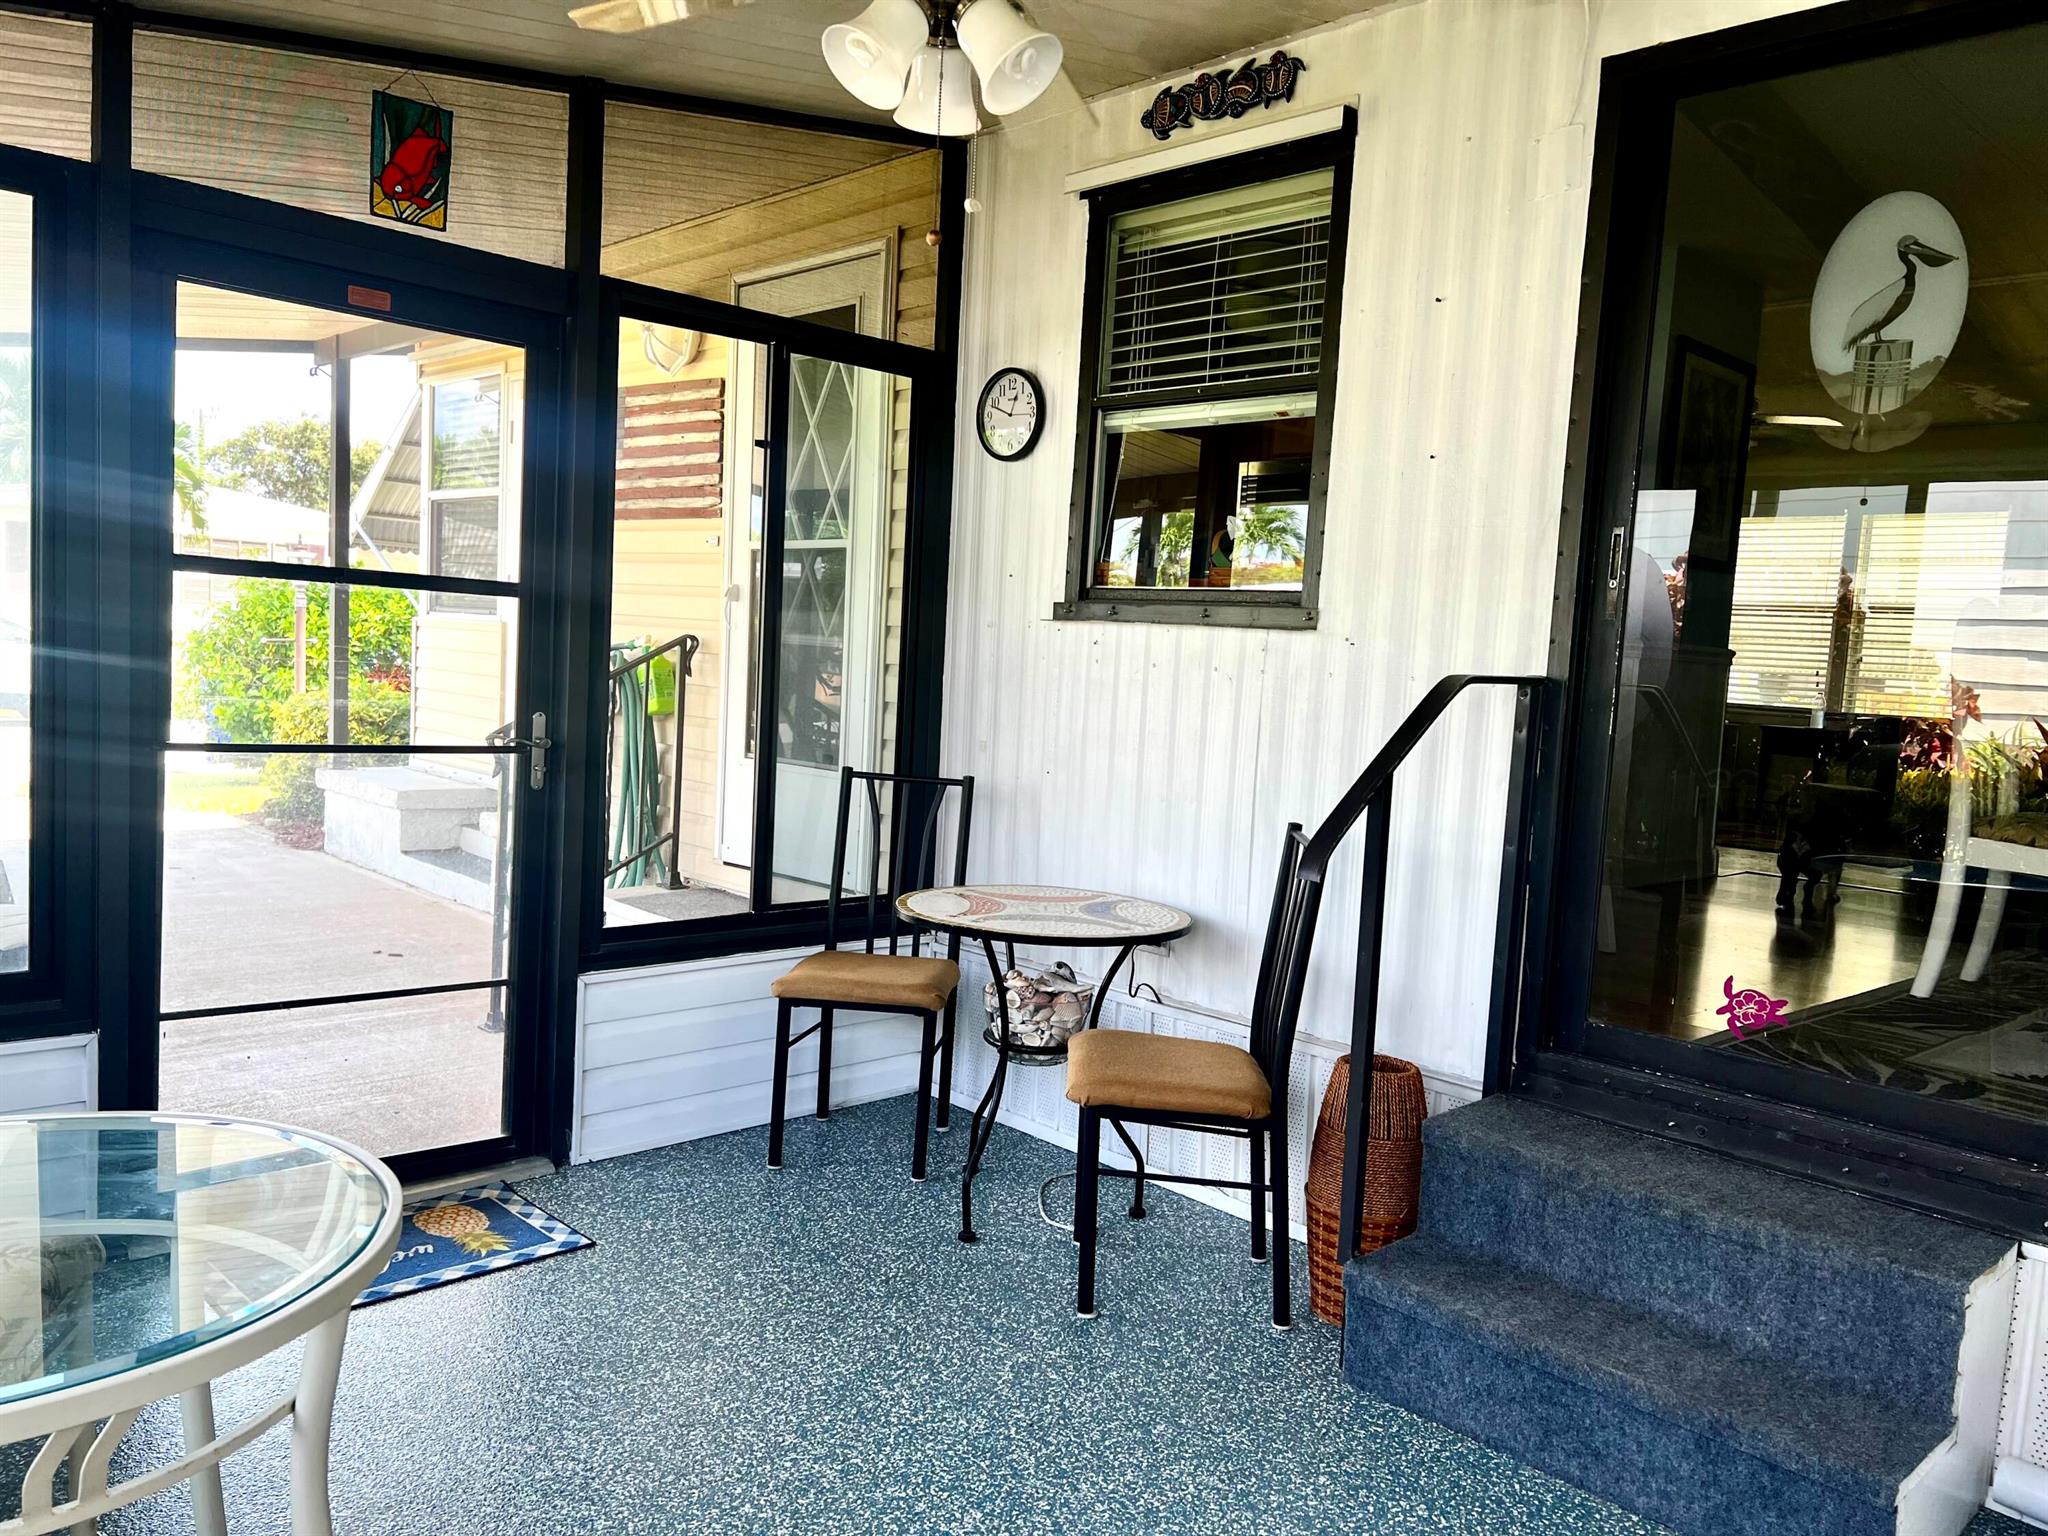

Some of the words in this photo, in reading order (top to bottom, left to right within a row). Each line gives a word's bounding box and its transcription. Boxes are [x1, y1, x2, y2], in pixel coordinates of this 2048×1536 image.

[1000, 384, 1006, 396] 11
[1008, 378, 1016, 390] 12
[1022, 382, 1024, 394] 1
[992, 396, 1000, 408] 10
[1026, 392, 1032, 404] 2
[987, 411, 992, 423] 9
[1030, 406, 1035, 418] 3
[990, 425, 996, 437] 8
